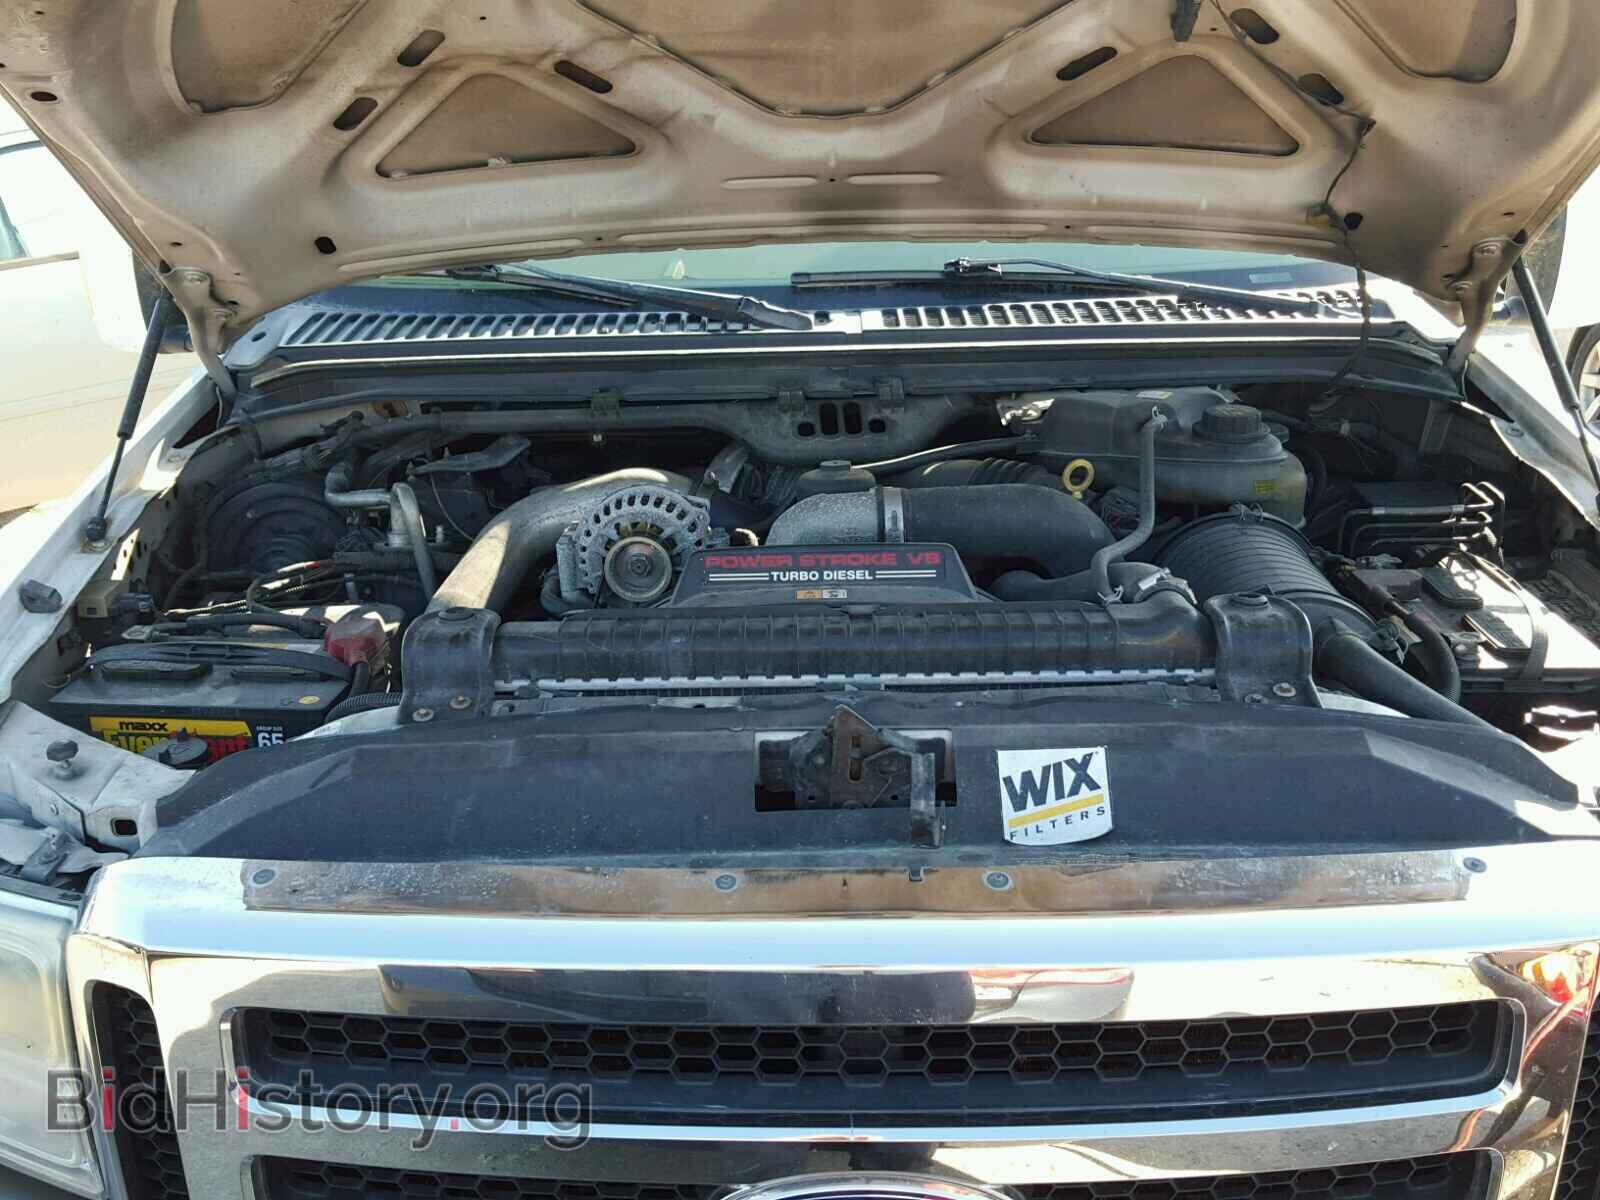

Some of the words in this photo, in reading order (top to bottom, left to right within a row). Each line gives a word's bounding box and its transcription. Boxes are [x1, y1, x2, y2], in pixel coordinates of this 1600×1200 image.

[704, 554, 793, 569] POWER
[799, 552, 897, 567] STROKE
[907, 551, 942, 565] V8
[771, 571, 819, 582] TURBO
[824, 569, 873, 581] DIESEL
[257, 732, 284, 747] 65
[1002, 752, 1101, 813] WIX
[1009, 806, 1105, 840] FILTERS
